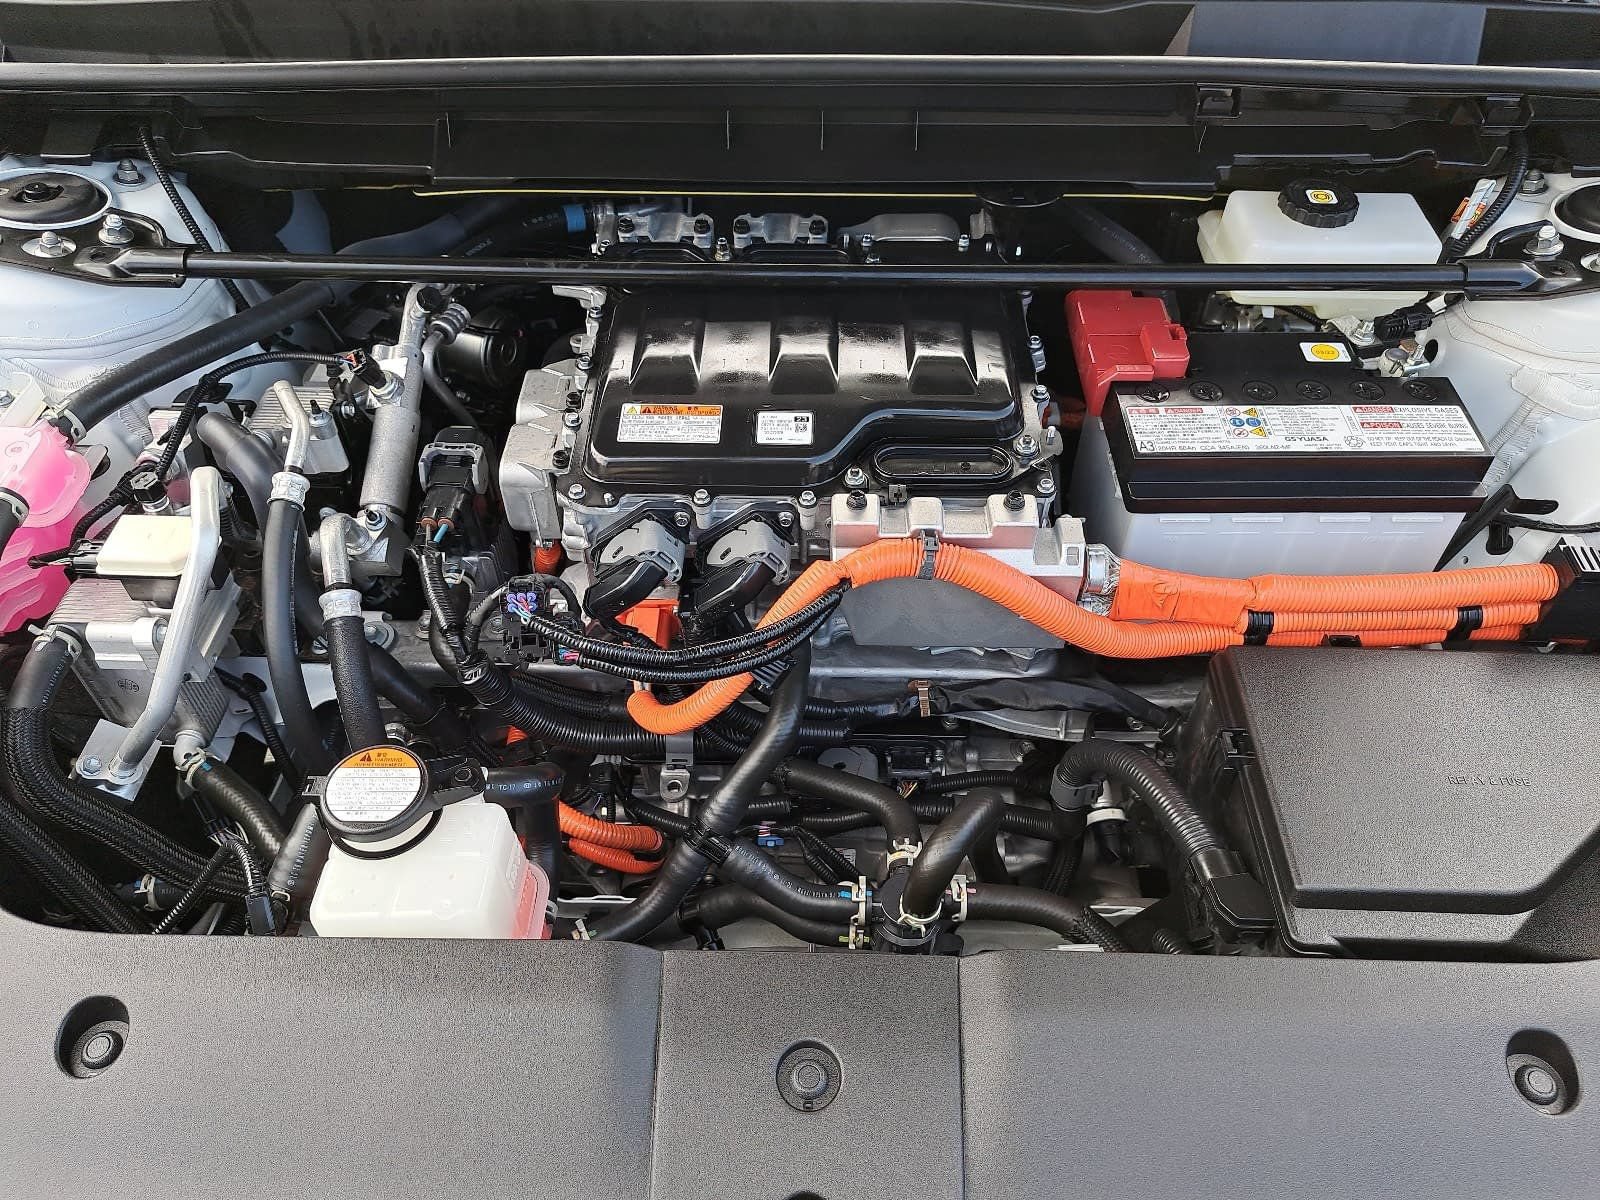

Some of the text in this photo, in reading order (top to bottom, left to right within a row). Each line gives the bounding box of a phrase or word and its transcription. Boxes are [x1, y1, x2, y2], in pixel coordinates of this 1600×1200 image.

[1140, 441, 1155, 451] A3
[1488, 776, 1499, 786] &
[1499, 777, 1532, 787] FUSE
